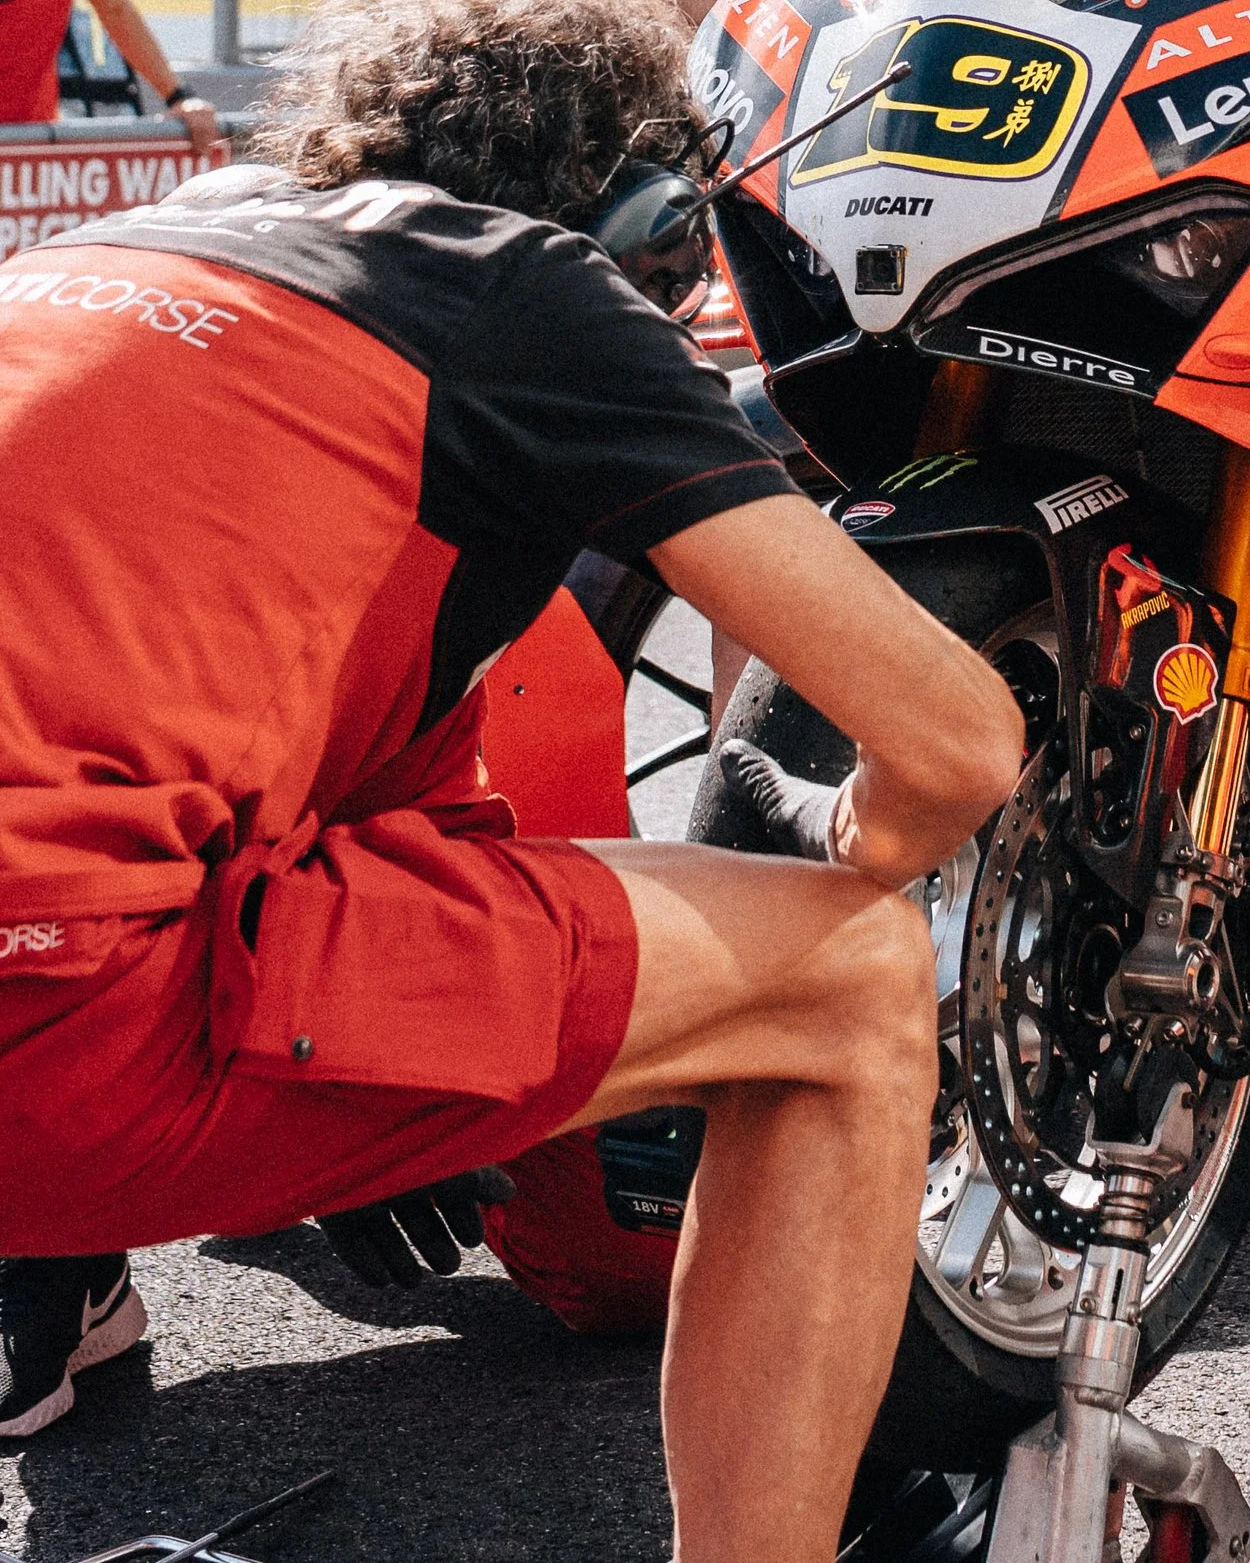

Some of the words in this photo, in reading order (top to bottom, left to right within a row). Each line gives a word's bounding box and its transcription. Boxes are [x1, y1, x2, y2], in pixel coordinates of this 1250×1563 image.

[844, 195, 935, 219] DUCATI
[979, 335, 1136, 387] Dierre
[1033, 474, 1130, 535] PIRELLI
[632, 1199, 660, 1215] 18V
